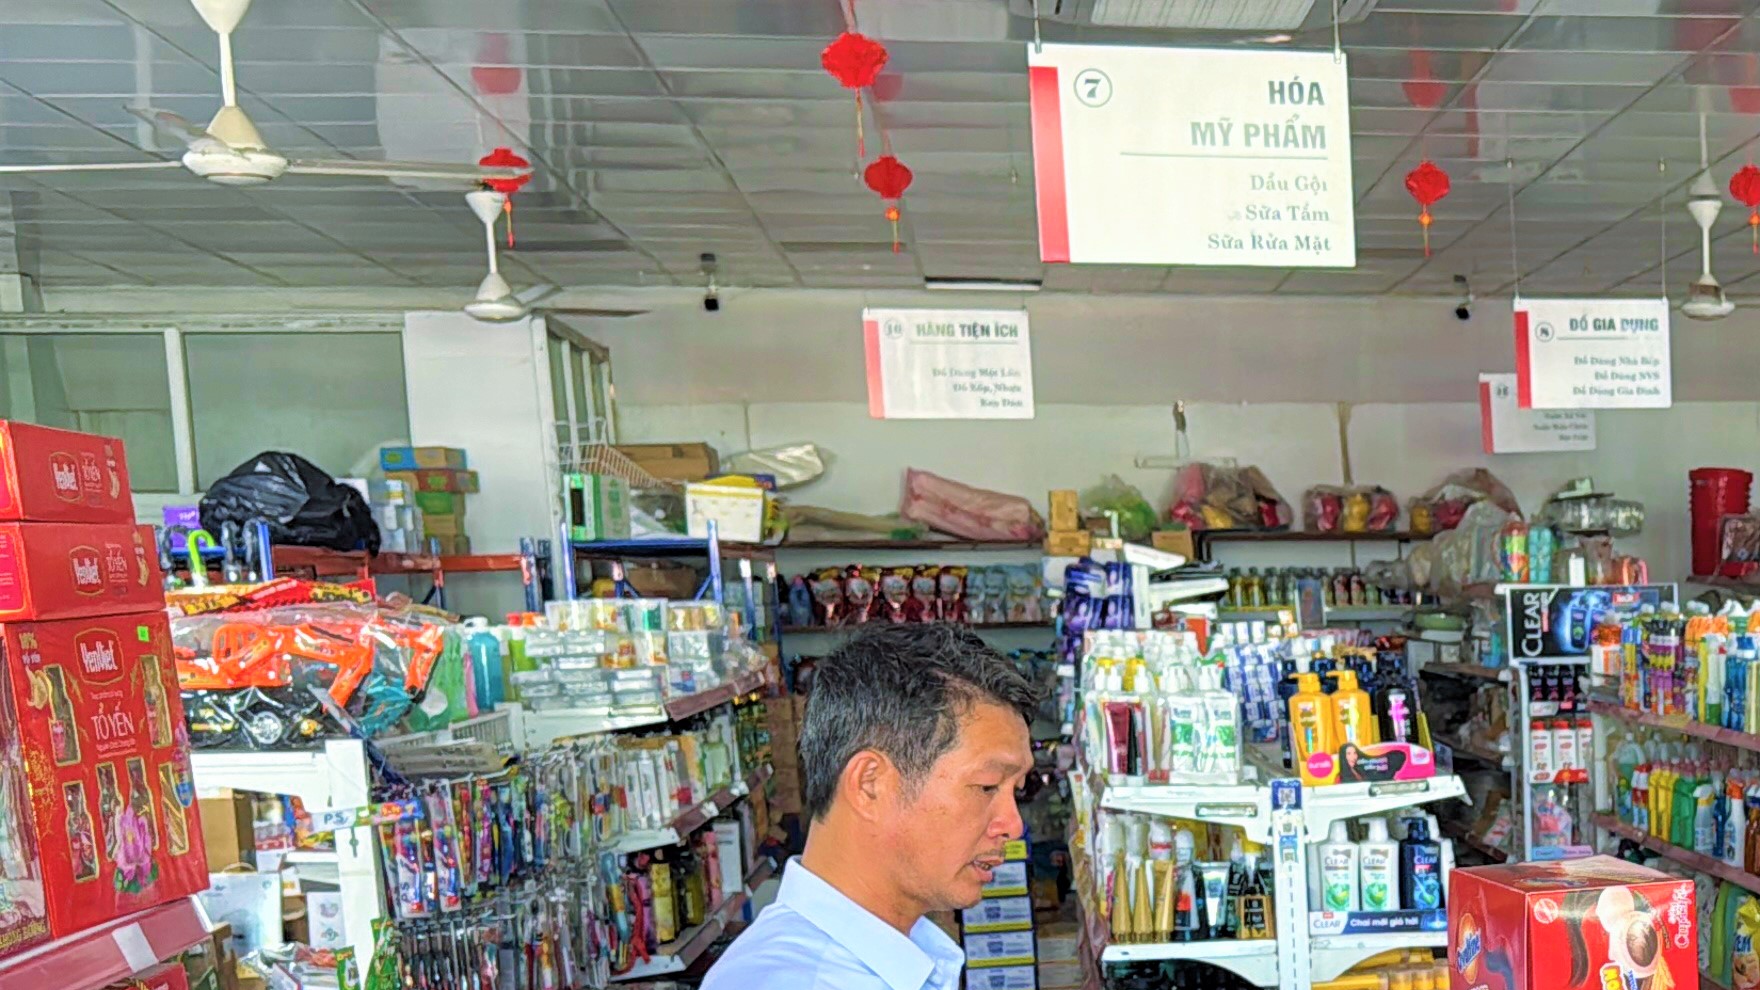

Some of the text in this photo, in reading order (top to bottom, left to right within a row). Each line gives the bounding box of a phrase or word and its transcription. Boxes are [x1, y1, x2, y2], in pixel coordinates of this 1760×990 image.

[1083, 78, 1102, 99] 7
[1267, 75, 1325, 106] HÓA
[1190, 113, 1327, 150] MỸ PHẨM
[1294, 174, 1329, 196] Gội
[1245, 203, 1281, 222] Sữa
[1207, 232, 1332, 256] Sữa Rửa Mặt
[916, 320, 955, 338] HÀNG
[958, 321, 991, 341] TIỆN
[1569, 314, 1660, 334] ĐỒ GIA DỤNG
[1520, 591, 1545, 658] CLEAR
